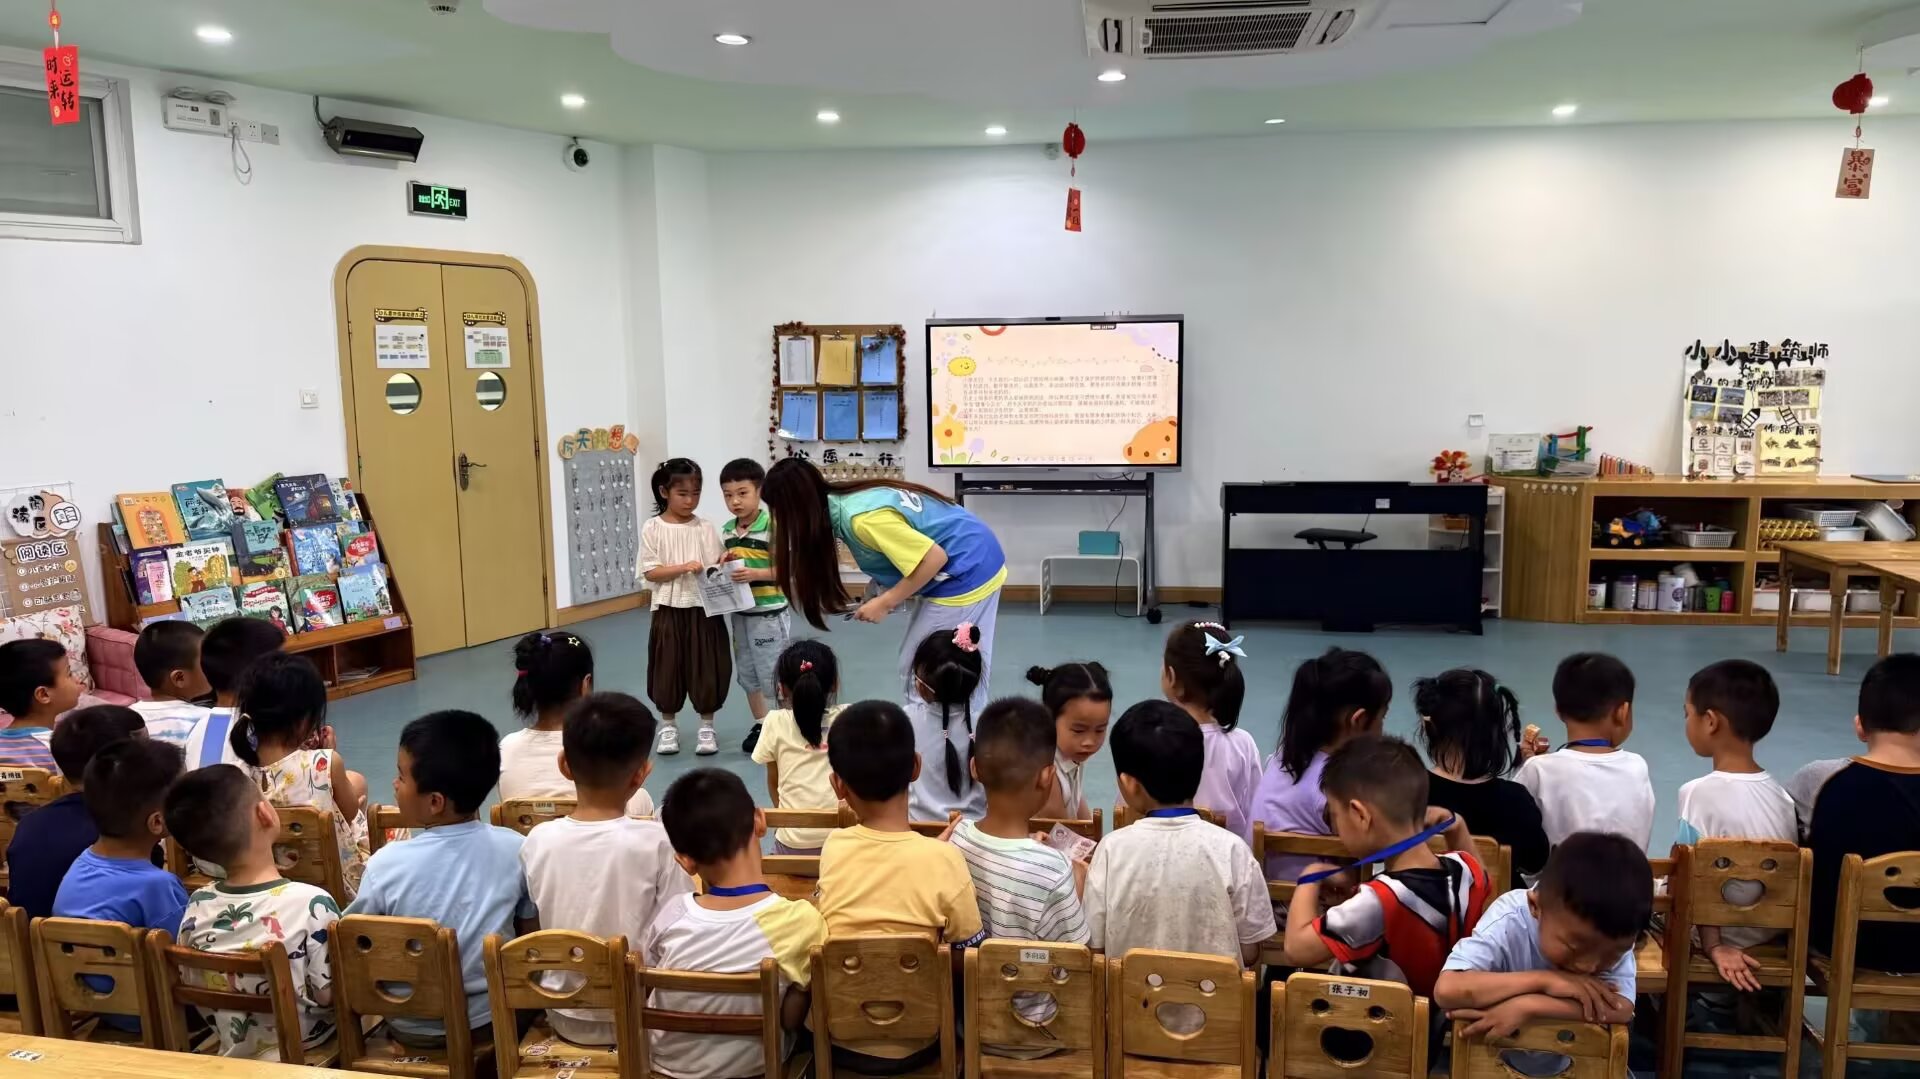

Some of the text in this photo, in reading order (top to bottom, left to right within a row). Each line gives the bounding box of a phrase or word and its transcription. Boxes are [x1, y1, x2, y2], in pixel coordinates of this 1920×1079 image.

[60, 70, 75, 111] 运转
[449, 198, 461, 208] EXIT
[1684, 338, 1829, 361] 小小建筑师
[17, 541, 68, 562] 阅读区
[175, 546, 220, 558] 金老爷买钟
[1331, 983, 1369, 997] 张子初
